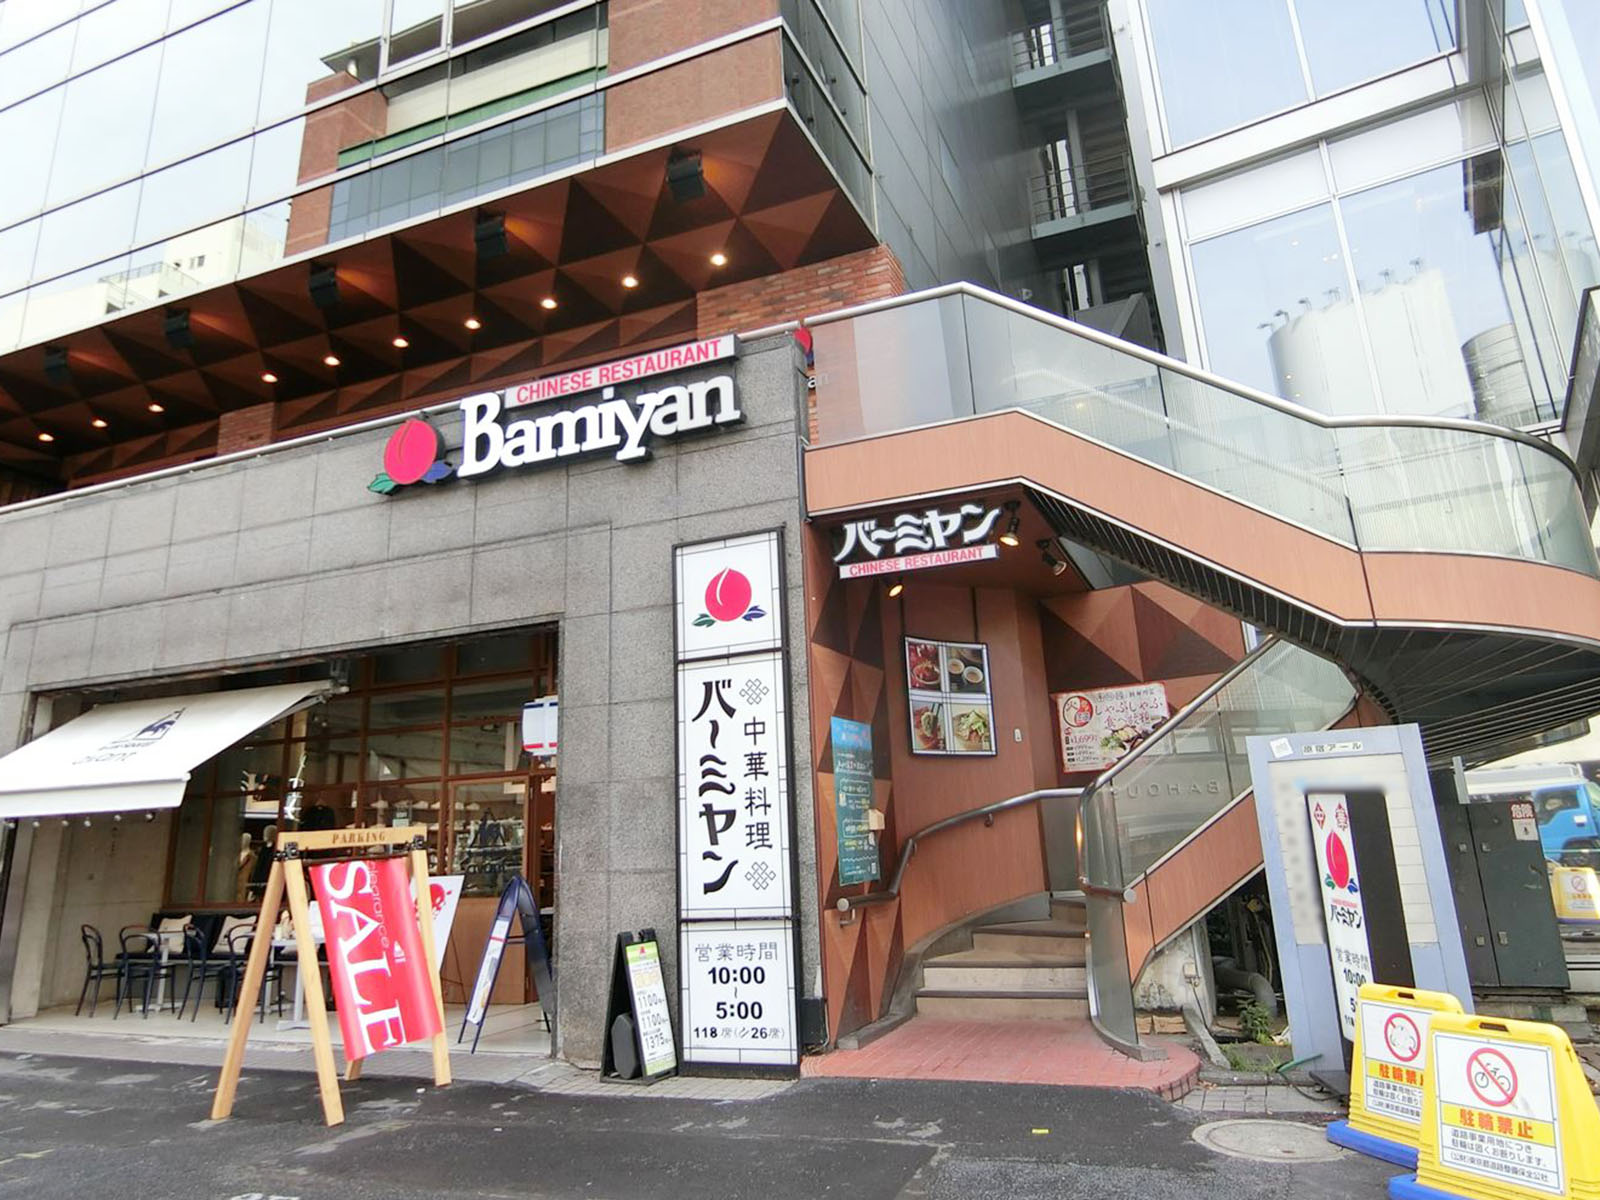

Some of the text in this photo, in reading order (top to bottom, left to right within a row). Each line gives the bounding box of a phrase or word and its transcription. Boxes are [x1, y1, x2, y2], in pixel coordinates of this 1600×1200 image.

[517, 338, 721, 403] CHINESE RESTAURANT
[457, 375, 741, 478] Bamiyan
[833, 504, 1000, 562] バーミヤン
[850, 547, 983, 577] CHINESE RESTAURANT
[692, 679, 739, 895] バーミヤン
[744, 716, 773, 850] 中華料理
[331, 831, 386, 844] PARKING
[323, 861, 407, 1055] SALE
[695, 942, 778, 962] 営業時間
[708, 966, 765, 985] 10:00
[716, 1001, 763, 1020] 5:00
[1460, 1108, 1534, 1139] 駐輪禁止
